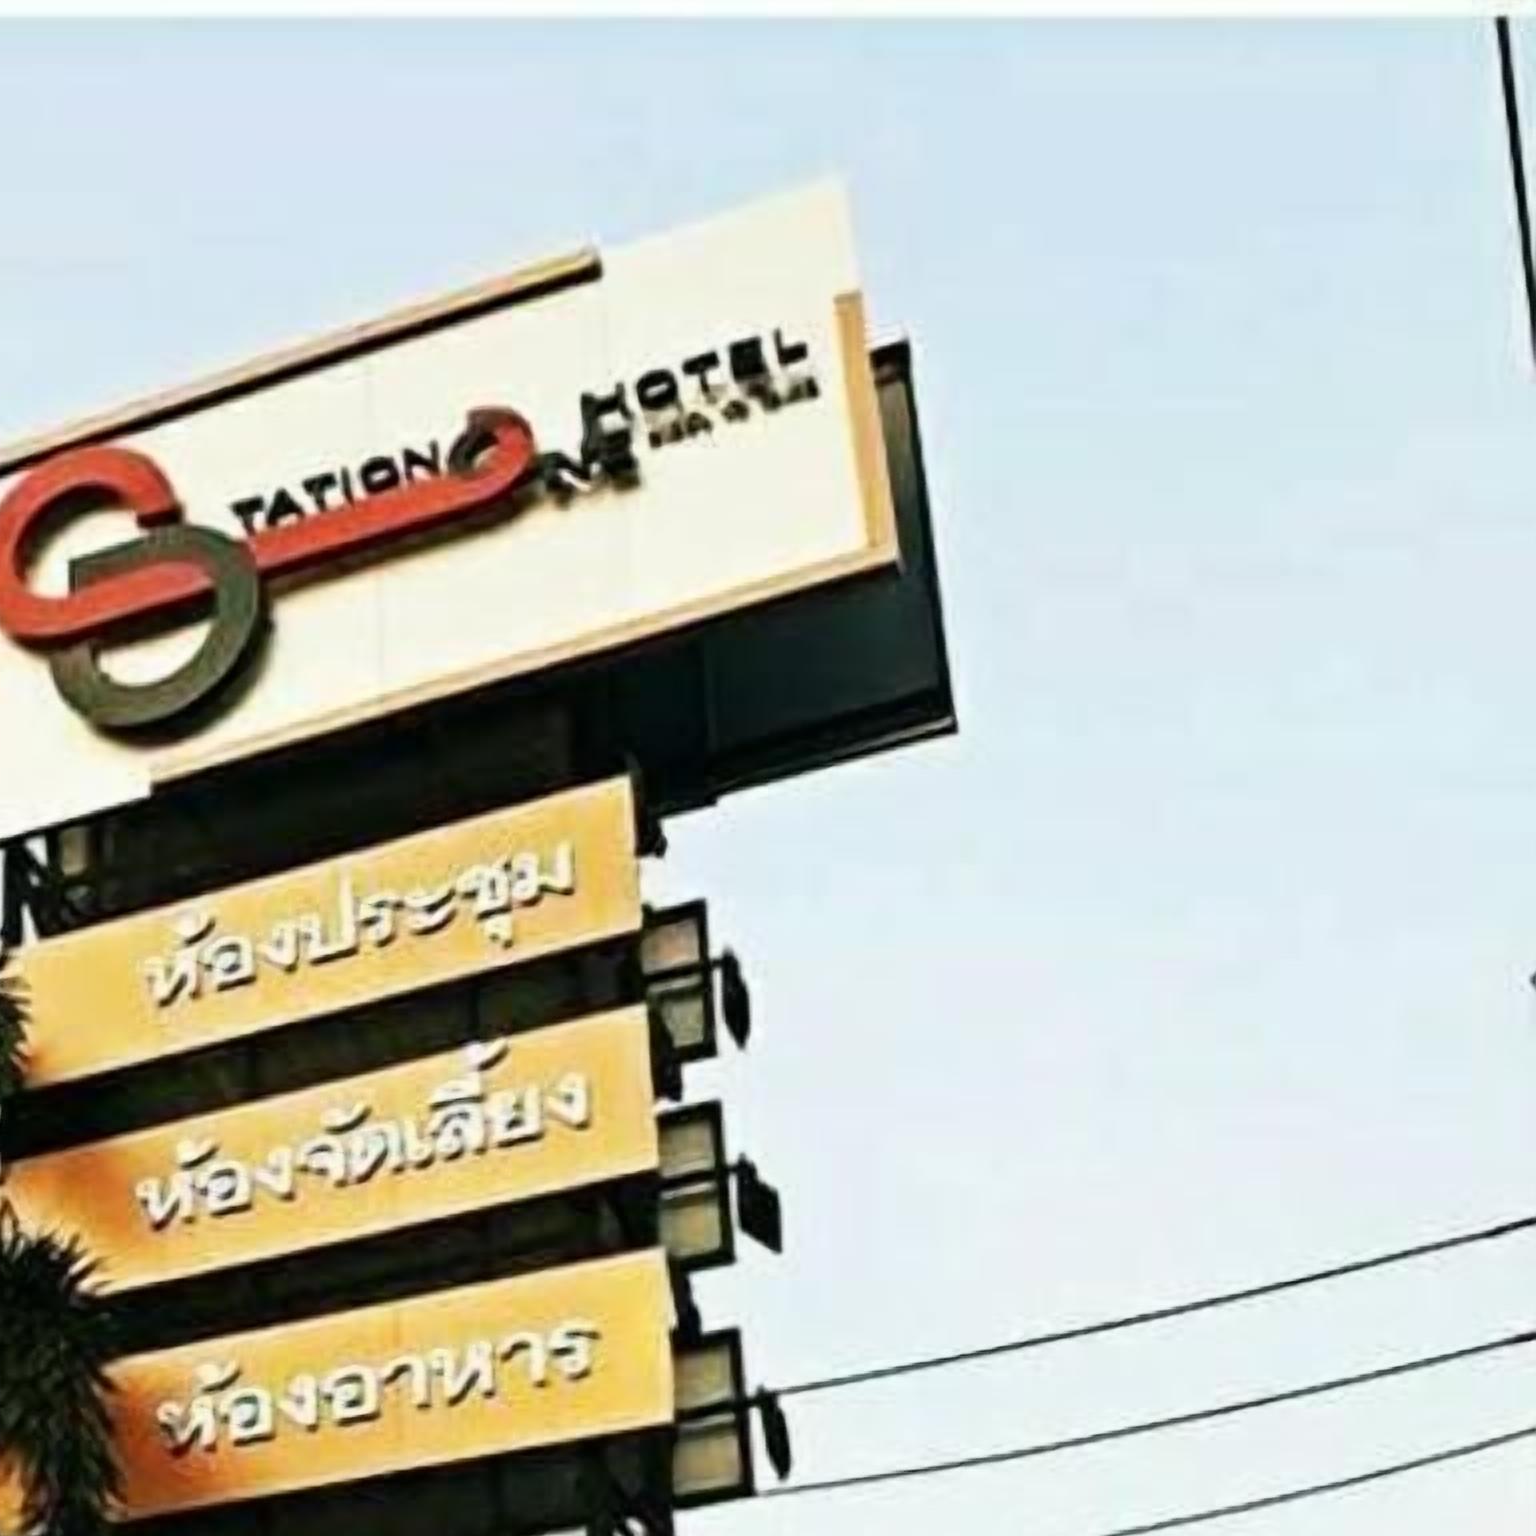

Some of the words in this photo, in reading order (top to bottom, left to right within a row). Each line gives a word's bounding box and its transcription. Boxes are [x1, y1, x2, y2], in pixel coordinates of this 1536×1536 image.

[142, 842, 574, 1006] ห้องประชุม
[134, 1038, 591, 1231] ห้องจัดเลี้ยง
[157, 1319, 601, 1456] ห้องอาหาร
